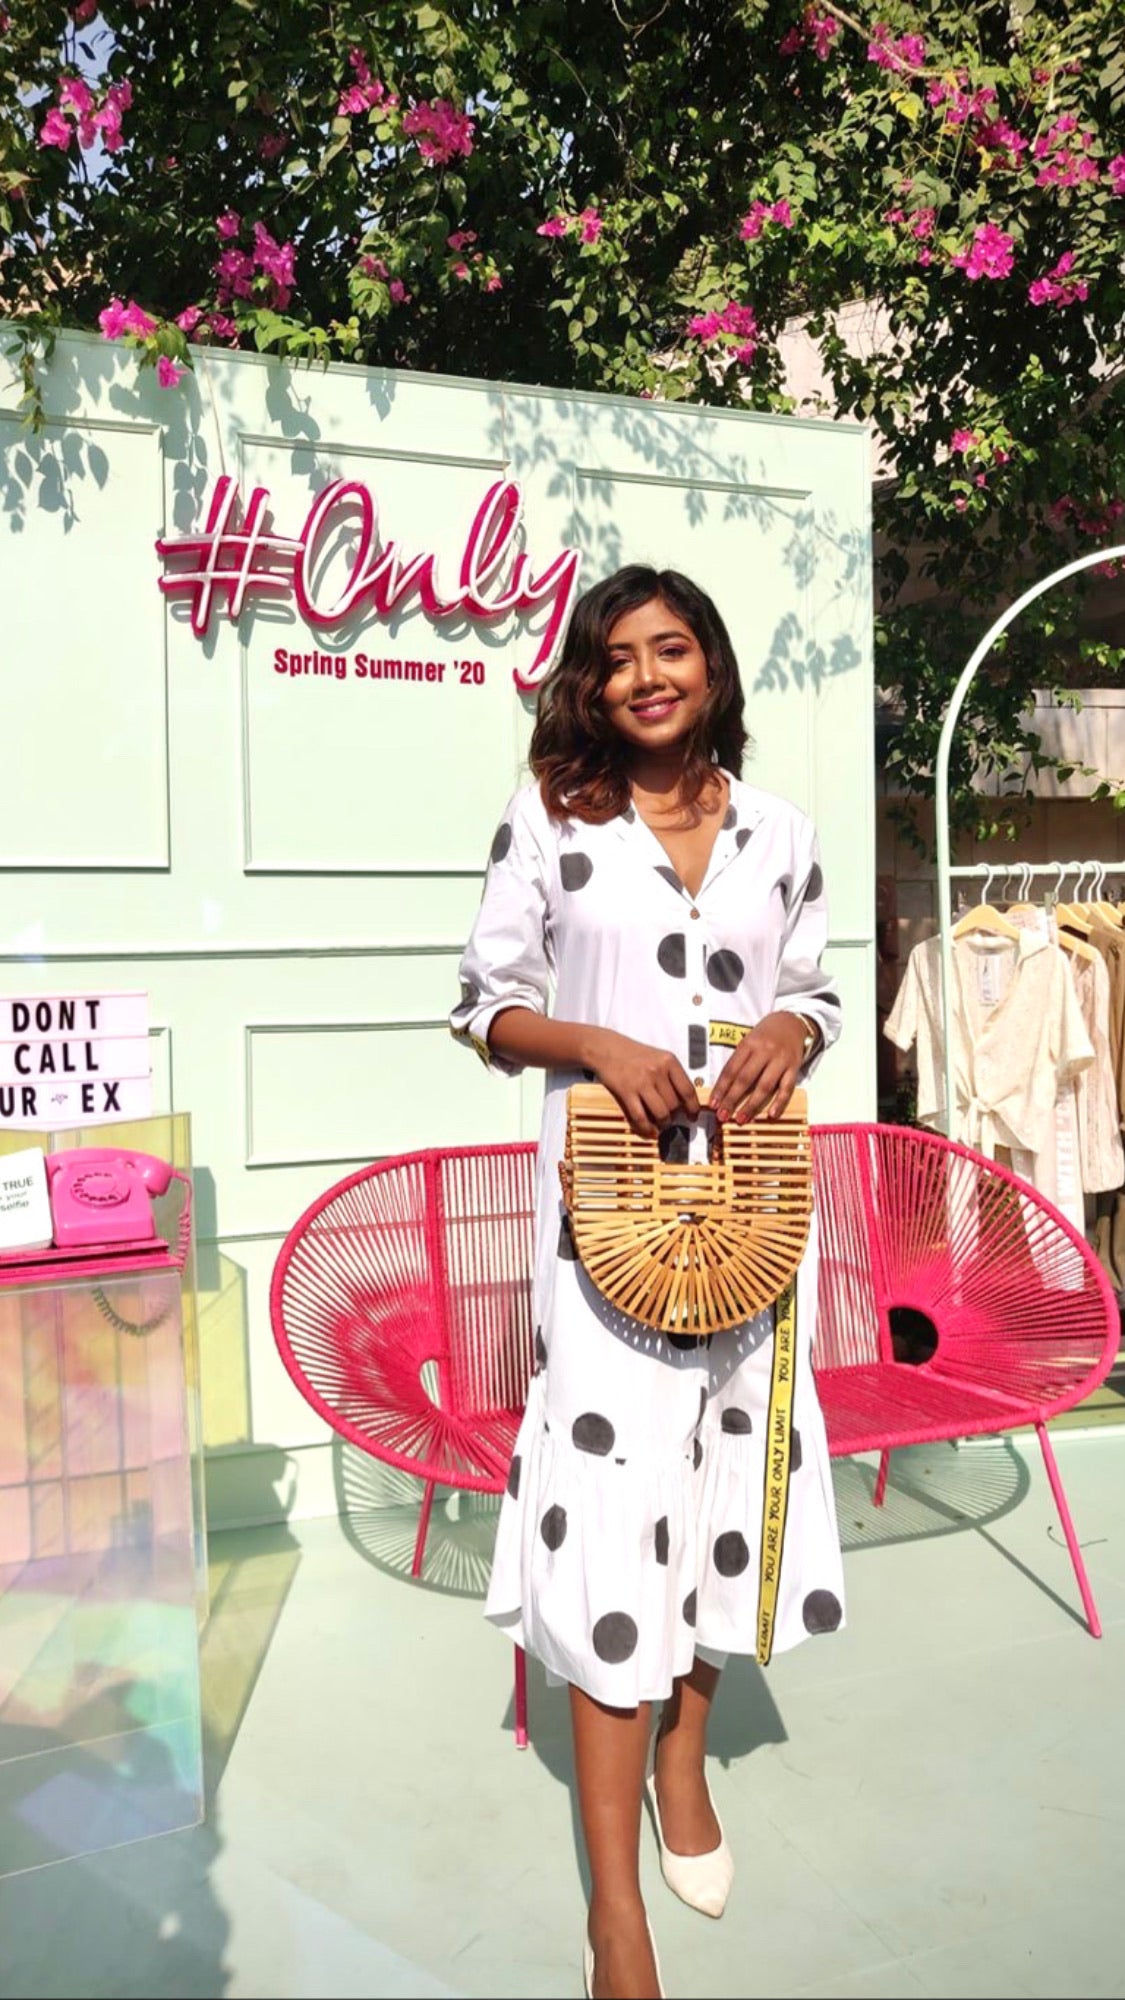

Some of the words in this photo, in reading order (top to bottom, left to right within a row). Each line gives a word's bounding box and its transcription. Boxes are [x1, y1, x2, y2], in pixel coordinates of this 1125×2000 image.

[154, 475, 582, 691] #Only
[274, 648, 347, 680] Spring
[354, 653, 446, 683] Summer
[453, 660, 486, 685] '20
[12, 999, 100, 1033] DONT
[14, 1041, 99, 1075] CALL
[81, 1081, 121, 1113] EX
[2, 1176, 34, 1191] TRUE
[780, 1327, 790, 1353] ARE
[778, 1357, 790, 1383] YOU
[774, 1407, 786, 1444] LIMIT
[772, 1446, 785, 1482] ONLY
[768, 1486, 782, 1521] YOUR
[767, 1525, 779, 1553] ARE
[764, 1555, 776, 1583] YOU
[760, 1608, 771, 1648] LIMIT
